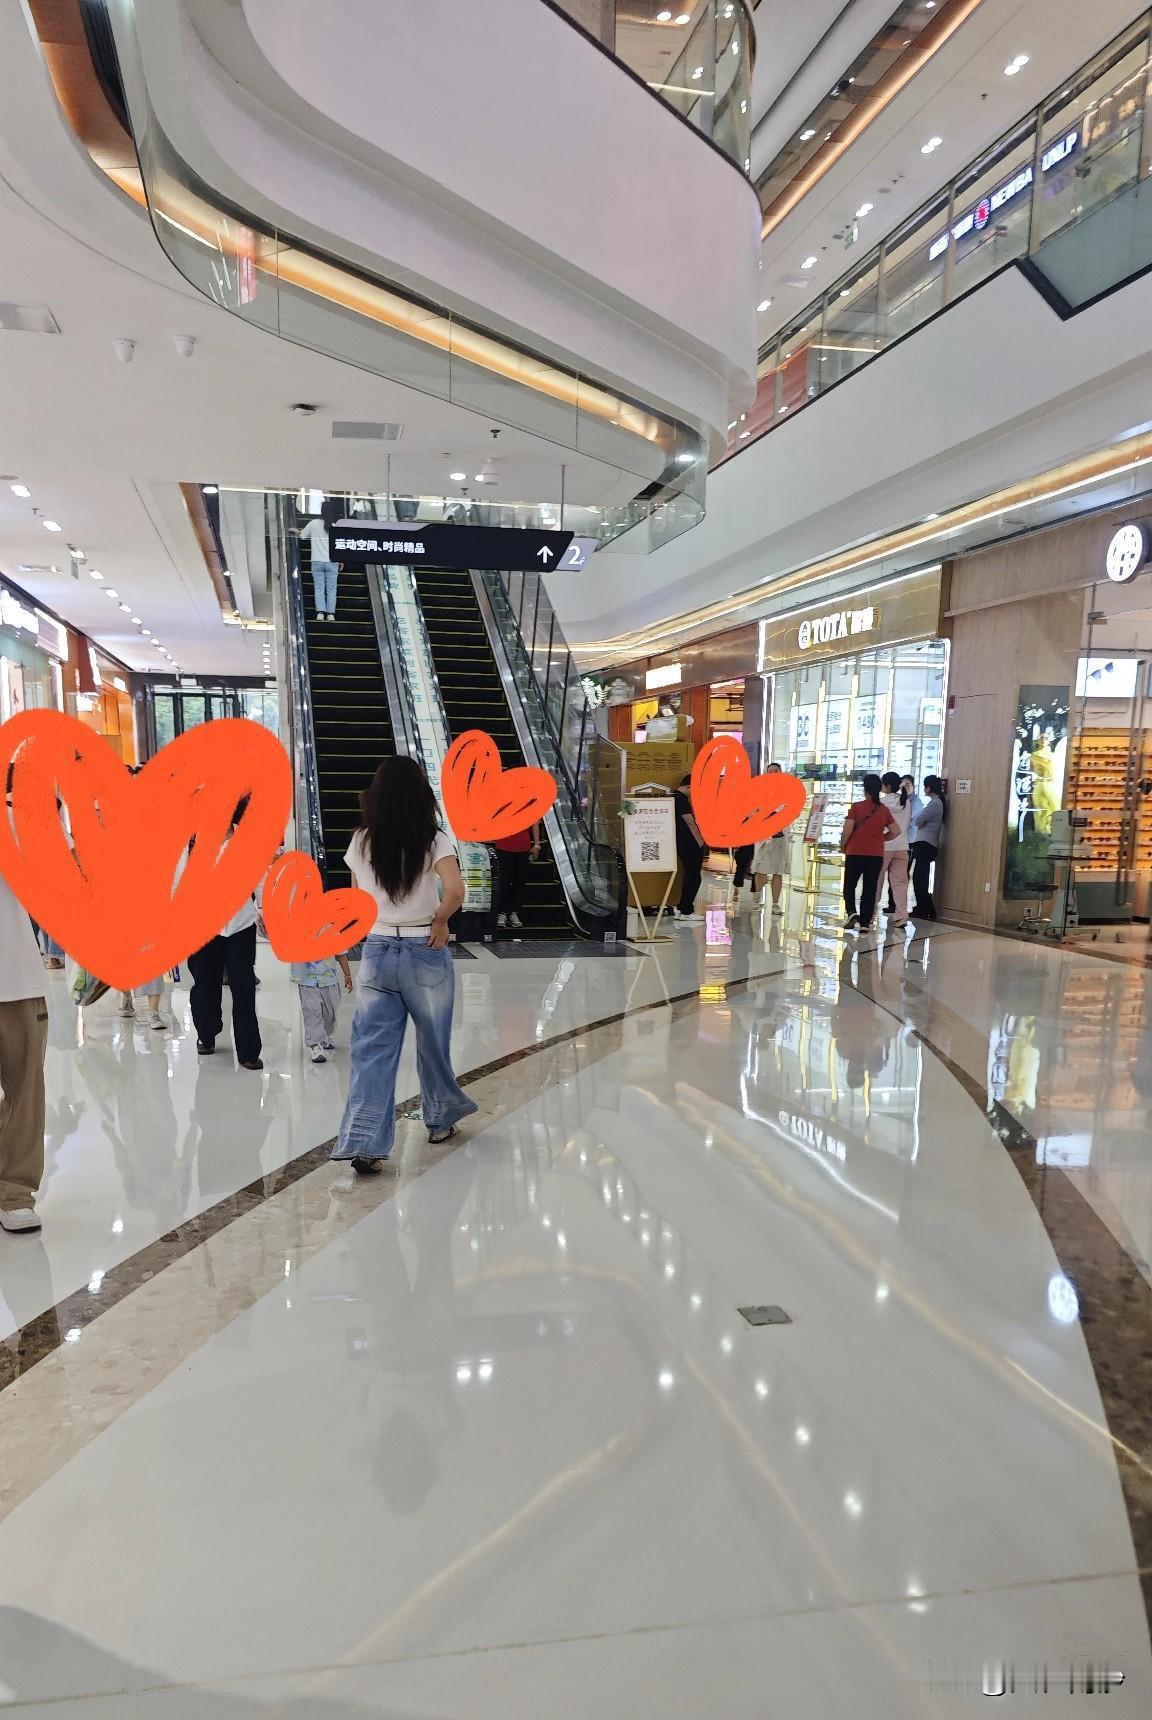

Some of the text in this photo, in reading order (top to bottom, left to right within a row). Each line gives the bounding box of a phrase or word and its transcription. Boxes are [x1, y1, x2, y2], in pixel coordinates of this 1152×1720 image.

[334, 538, 426, 554] 运动空间、时尚精品
